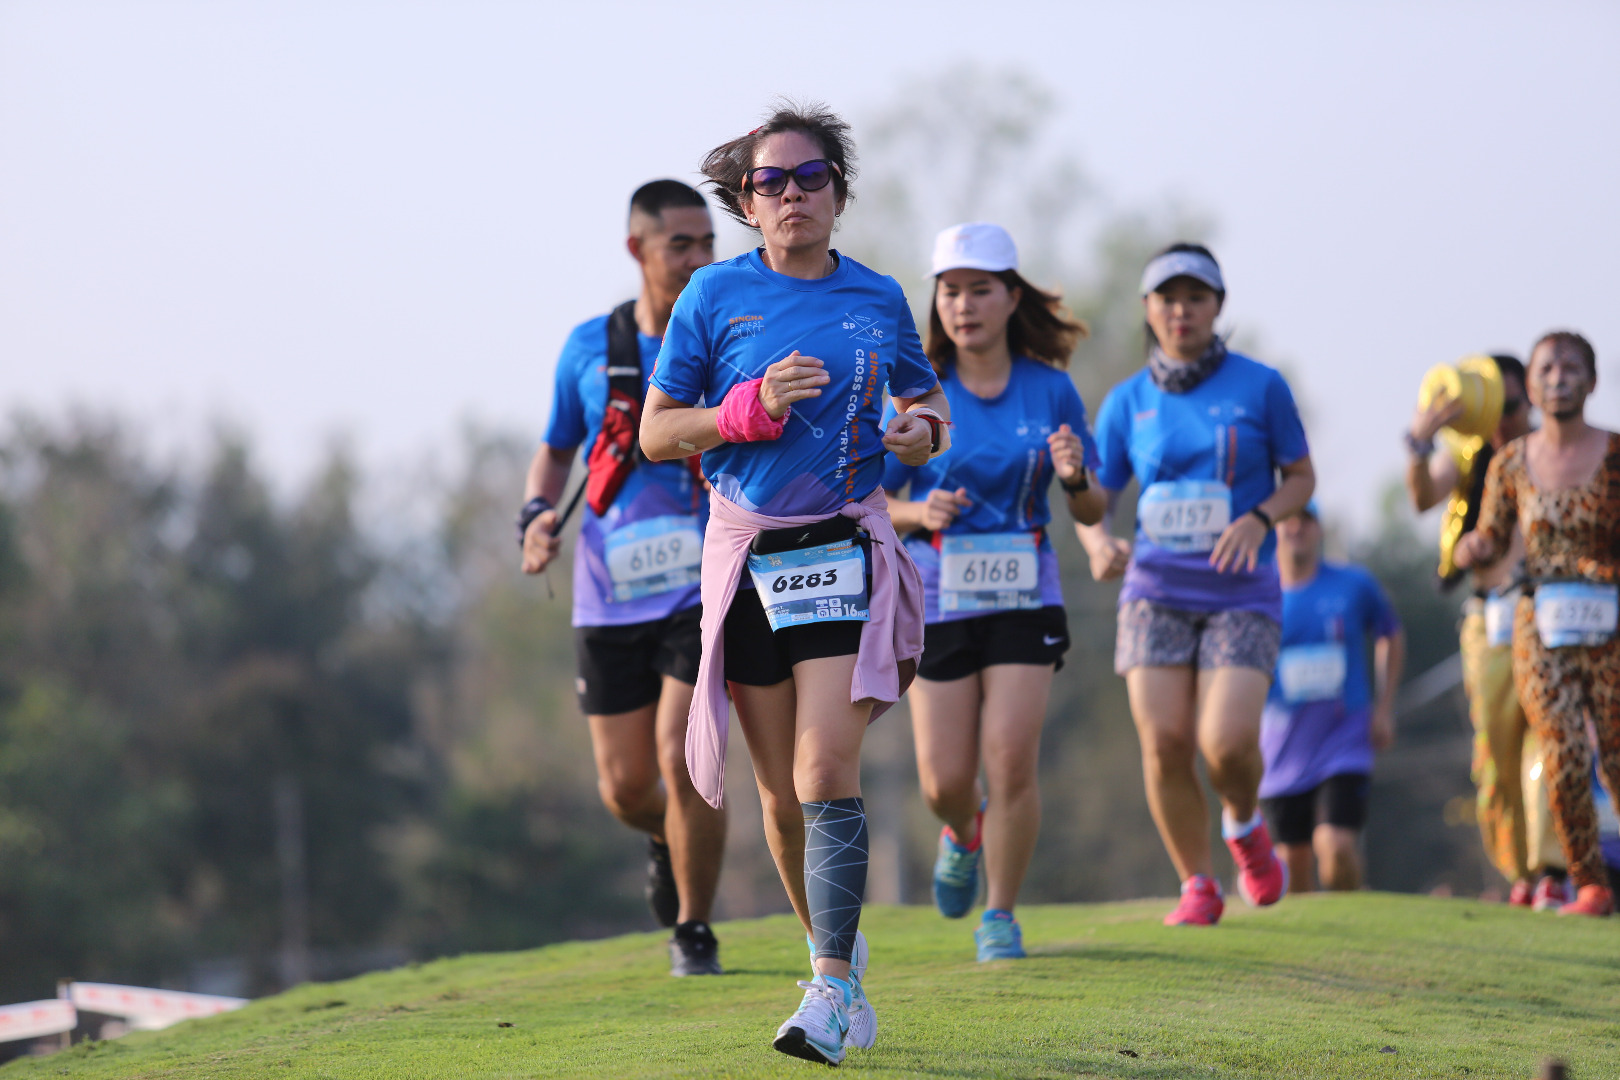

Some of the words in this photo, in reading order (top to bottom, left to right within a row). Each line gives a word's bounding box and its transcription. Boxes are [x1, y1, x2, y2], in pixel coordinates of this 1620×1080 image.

[729, 315, 764, 324] SINGHA
[730, 321, 758, 330] SERIES
[842, 322, 856, 330] SP
[872, 327, 883, 339] XC
[852, 348, 865, 391] CROSS
[862, 351, 879, 407] SINGHA
[850, 416, 860, 444] ARK
[1161, 504, 1212, 528] 6157
[630, 538, 682, 571] 6169
[772, 568, 838, 593] 6283
[963, 558, 1019, 583] 6168
[843, 603, 857, 618] 16
